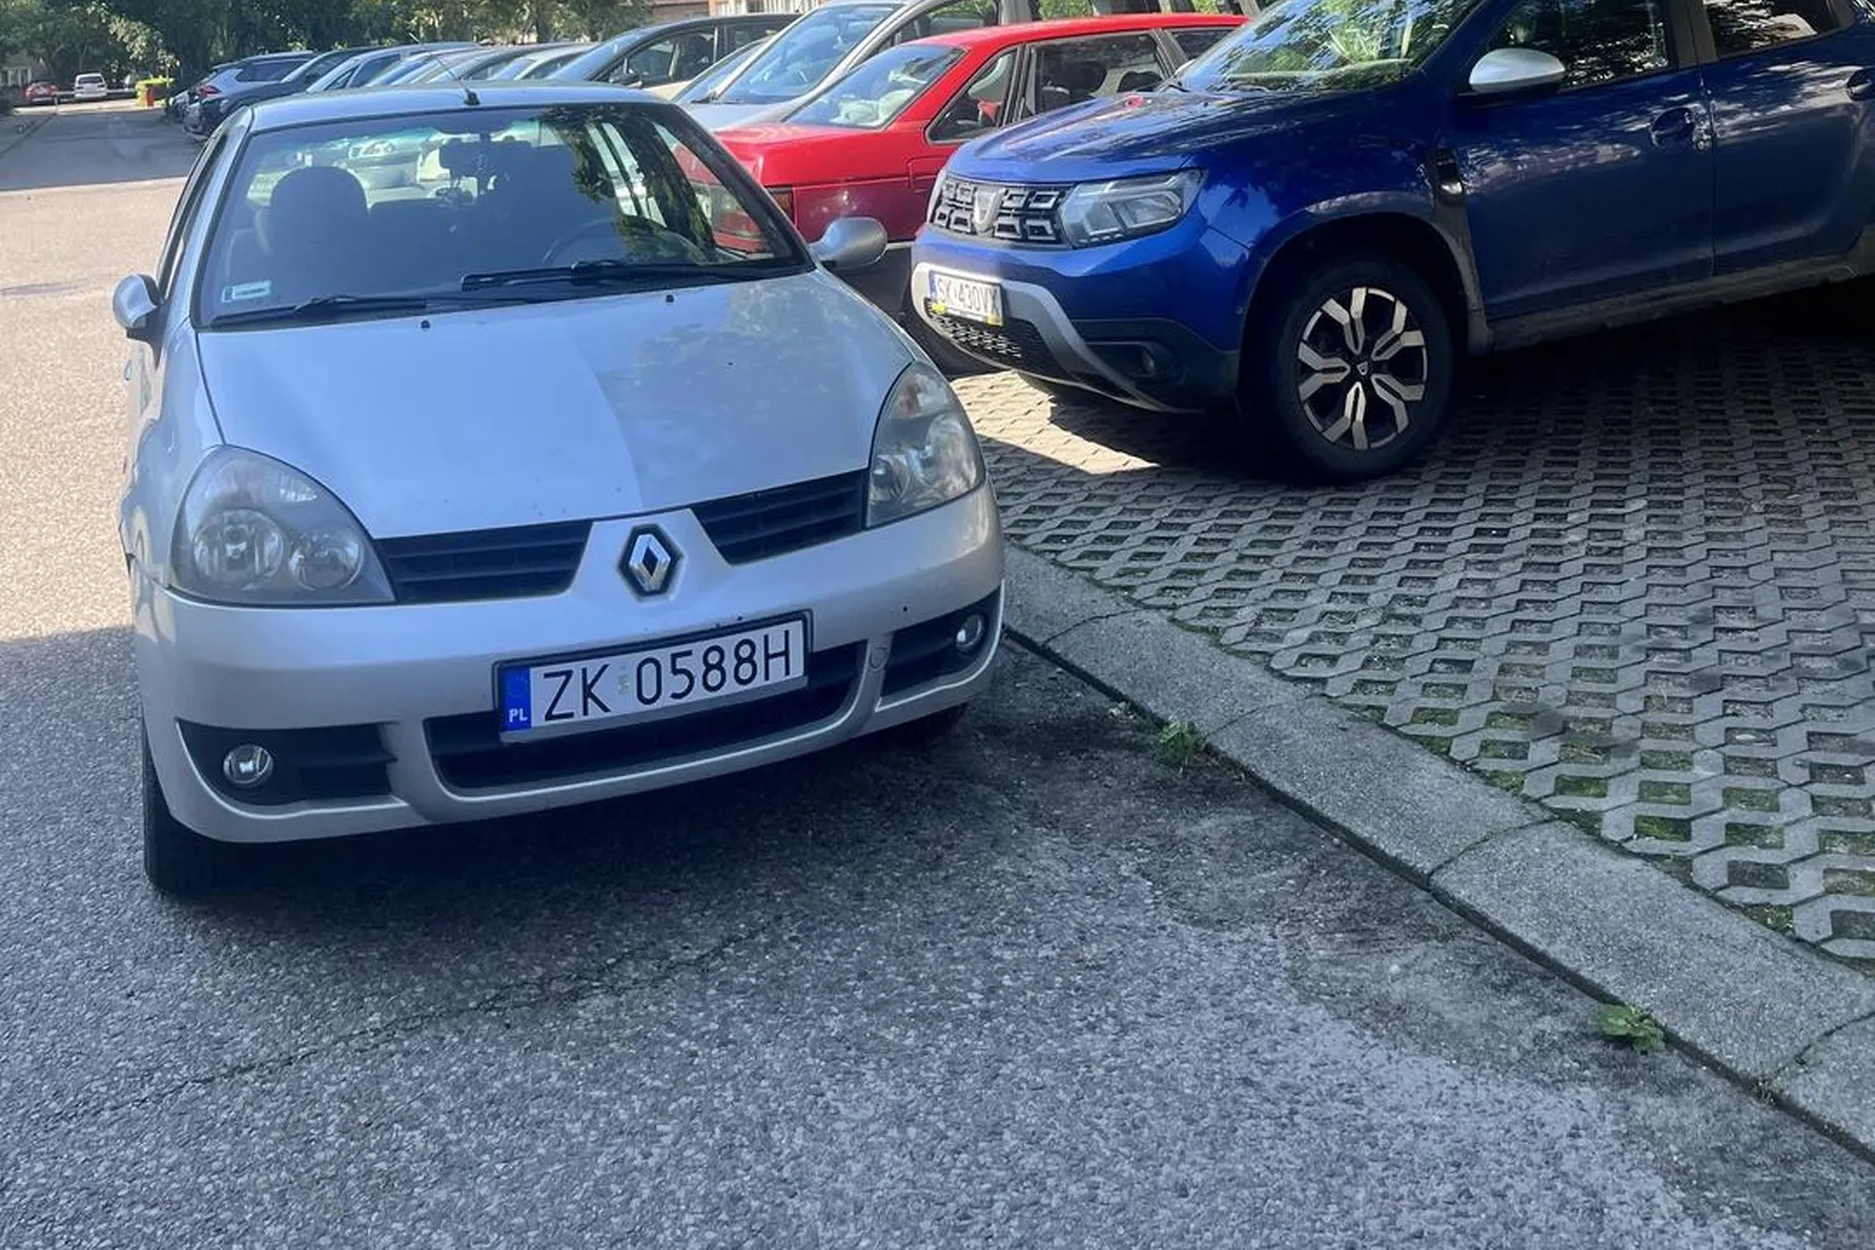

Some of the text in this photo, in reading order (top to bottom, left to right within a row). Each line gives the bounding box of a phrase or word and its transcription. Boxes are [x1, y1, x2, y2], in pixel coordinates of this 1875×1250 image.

[543, 629, 792, 722] ZK 0588H
[508, 707, 528, 723] PL
